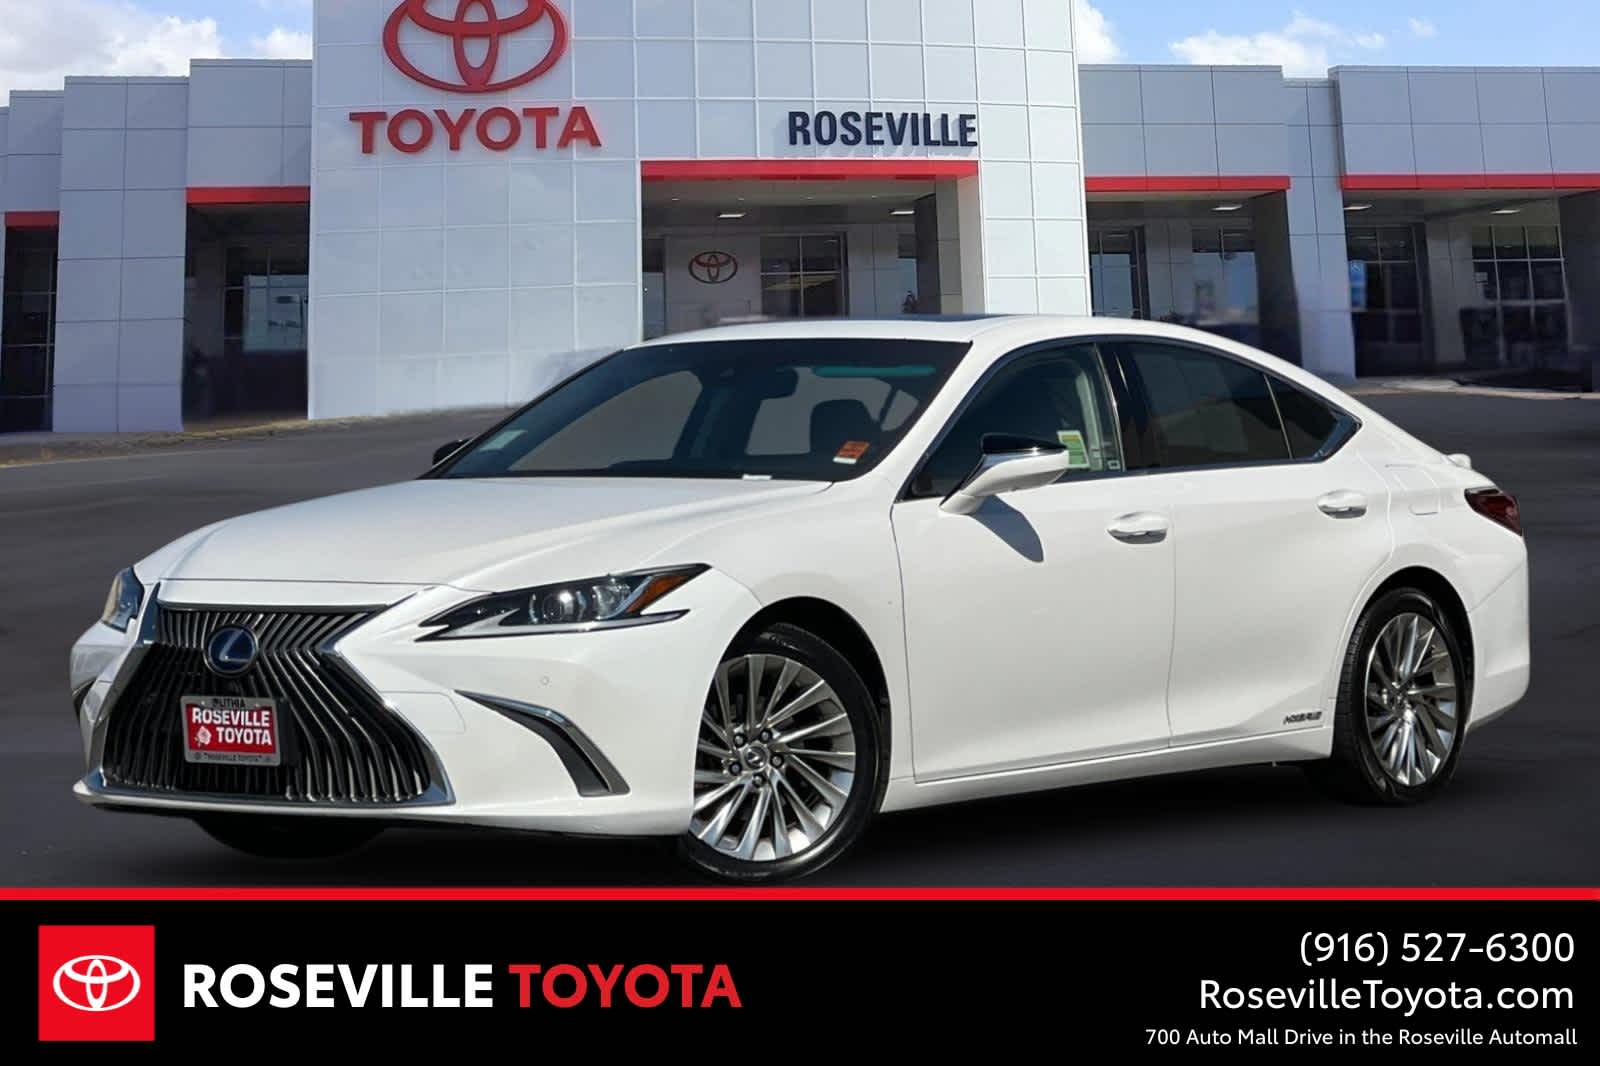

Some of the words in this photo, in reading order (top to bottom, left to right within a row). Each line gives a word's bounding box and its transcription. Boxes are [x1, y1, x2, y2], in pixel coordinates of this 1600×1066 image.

[349, 106, 602, 154] TOYOTA
[788, 110, 978, 147] ROSEVILLE
[192, 707, 271, 727] ROSEVILLE
[215, 727, 273, 745] TOYOTA
